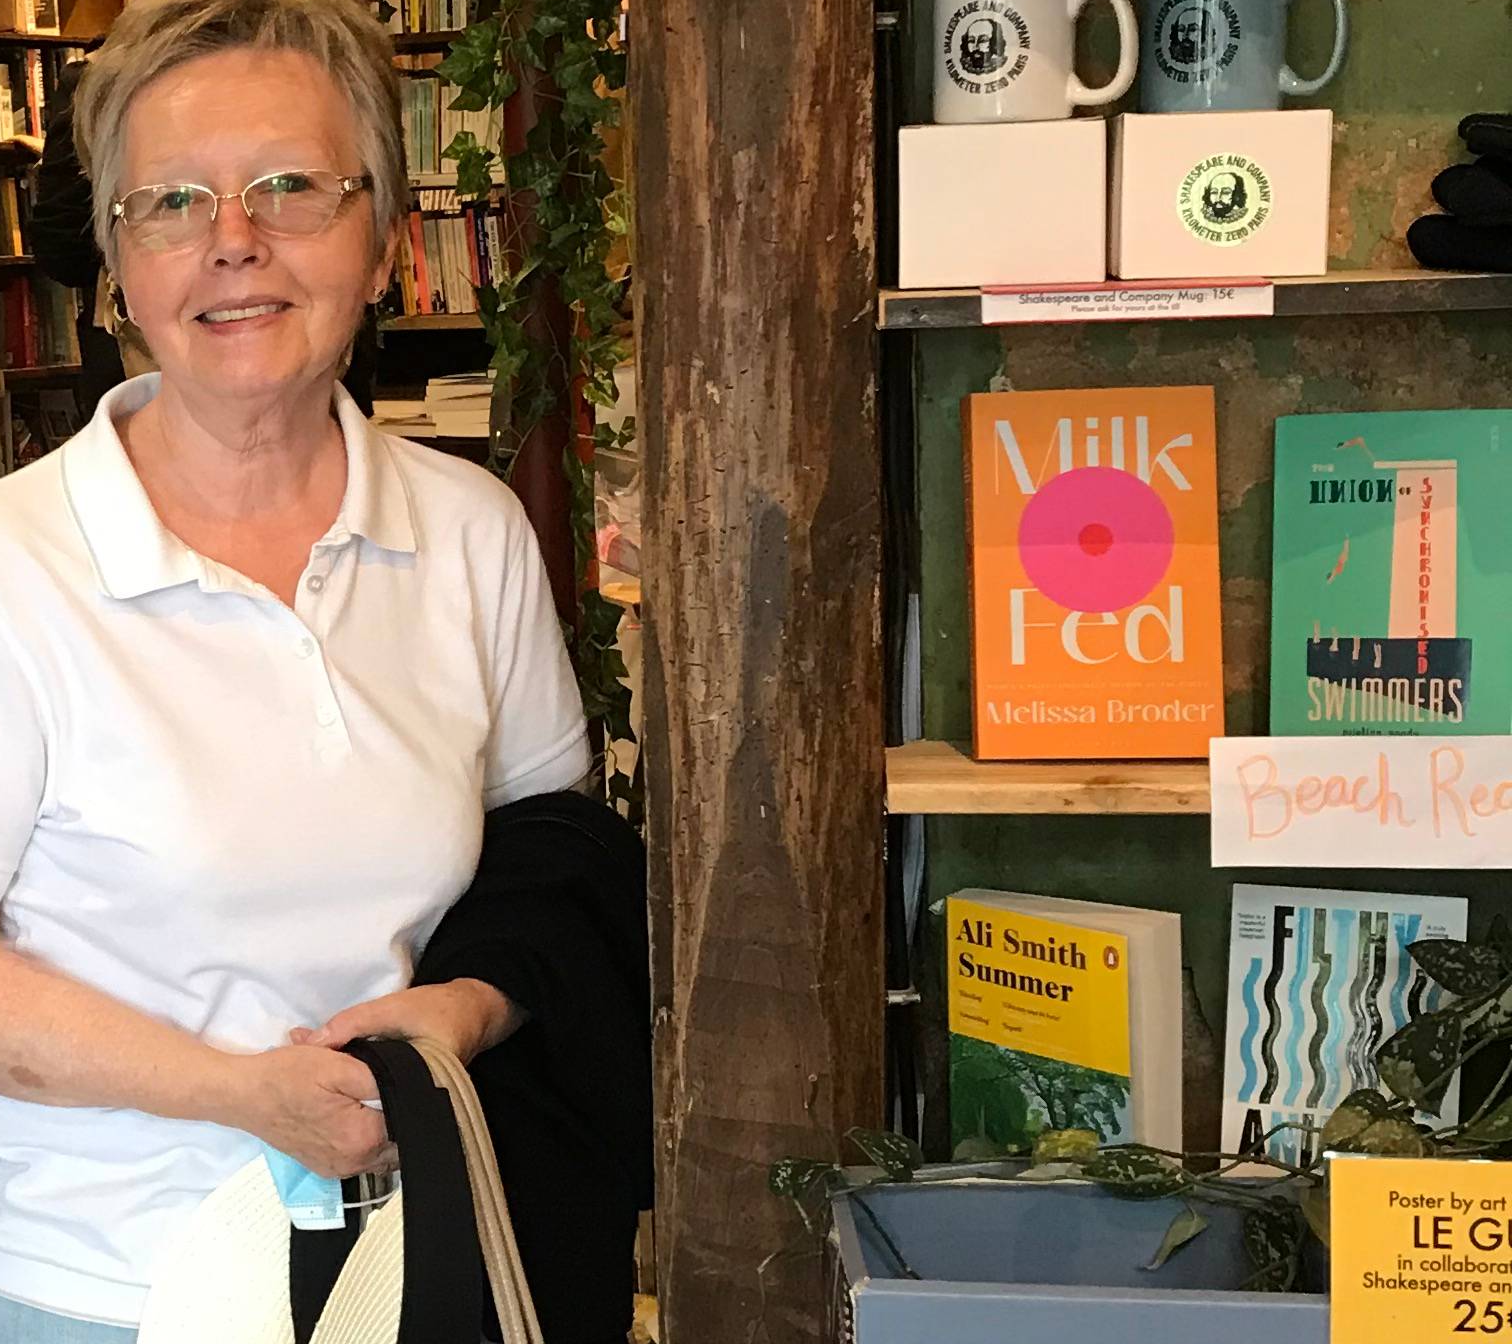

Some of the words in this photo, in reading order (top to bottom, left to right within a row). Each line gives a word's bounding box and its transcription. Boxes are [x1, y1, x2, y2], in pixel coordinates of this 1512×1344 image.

[1004, 6, 1031, 50] COMPANY
[944, 58, 982, 95] KILOMETER
[1009, 53, 1030, 82] PARIS
[1180, 155, 1224, 205] SHAKESPEARE
[1226, 155, 1247, 169] AND
[1246, 162, 1271, 204] COMPANY
[1182, 207, 1223, 242] KILOMETER
[1224, 226, 1249, 242] ZERO
[1247, 206, 1269, 231] PARIS
[1018, 292, 1090, 307] Shakespeare
[1093, 290, 1116, 303] and
[1118, 290, 1174, 306] Company
[1212, 288, 1236, 301] 15€
[995, 416, 1193, 496] Milk
[1309, 478, 1393, 505] UNION
[1416, 476, 1433, 675] SYNCHRONISED
[1009, 584, 1186, 666] Fed
[987, 698, 1096, 725] Melissa
[1107, 696, 1215, 724] Broder
[1307, 675, 1464, 724] SWIMMERS
[1236, 751, 1416, 842] Beach
[955, 917, 993, 949] Ali
[1002, 927, 1088, 971] Smith
[958, 950, 1075, 1003] Summer
[1389, 1190, 1445, 1209] Poster
[1450, 1191, 1474, 1216] by
[1480, 1197, 1507, 1212] art
[1414, 1215, 1453, 1250] LE
[1362, 1271, 1482, 1296] Shakespeare
[1397, 1254, 1414, 1271] in
